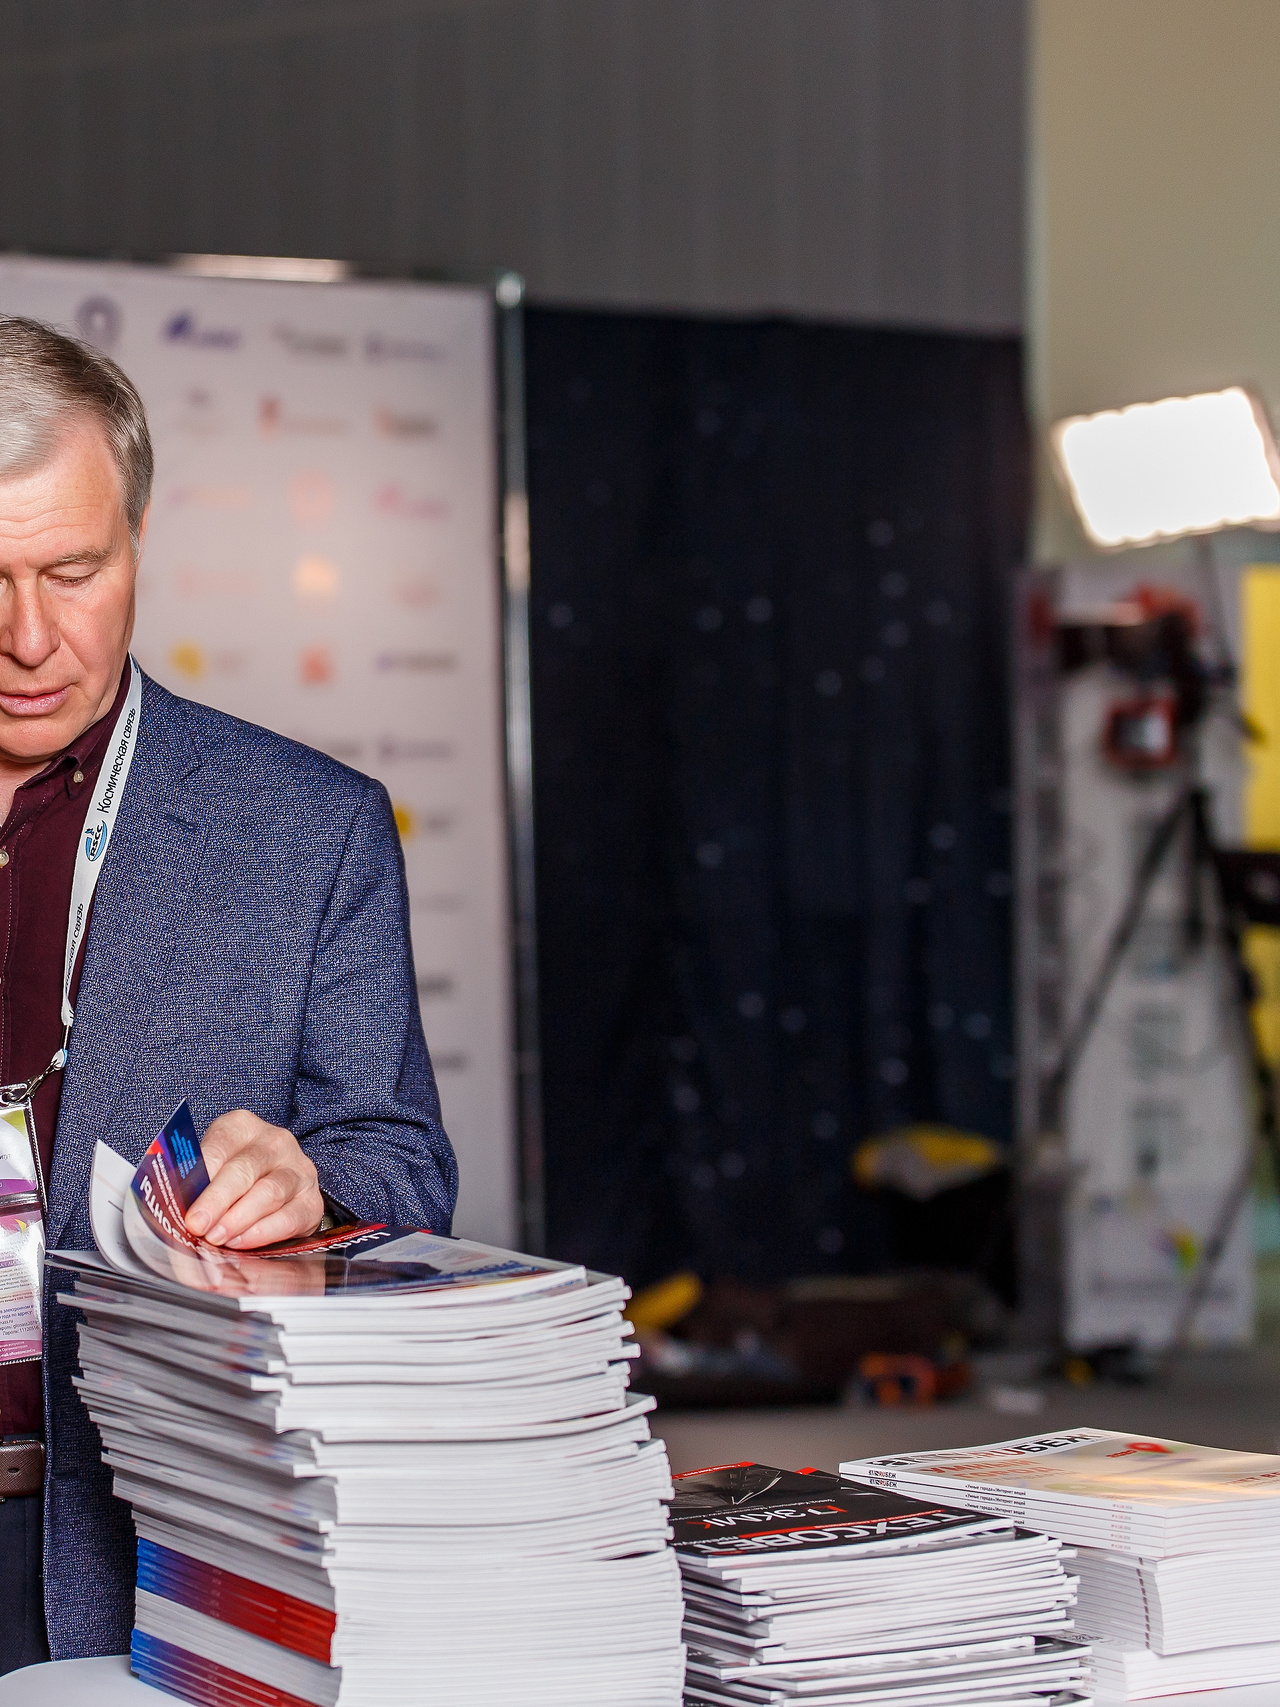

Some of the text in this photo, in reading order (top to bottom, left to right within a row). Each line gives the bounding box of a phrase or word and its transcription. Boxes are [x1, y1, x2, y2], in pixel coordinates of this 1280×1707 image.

[96, 706, 137, 815] Космическая связь
[72, 903, 84, 941] связь
